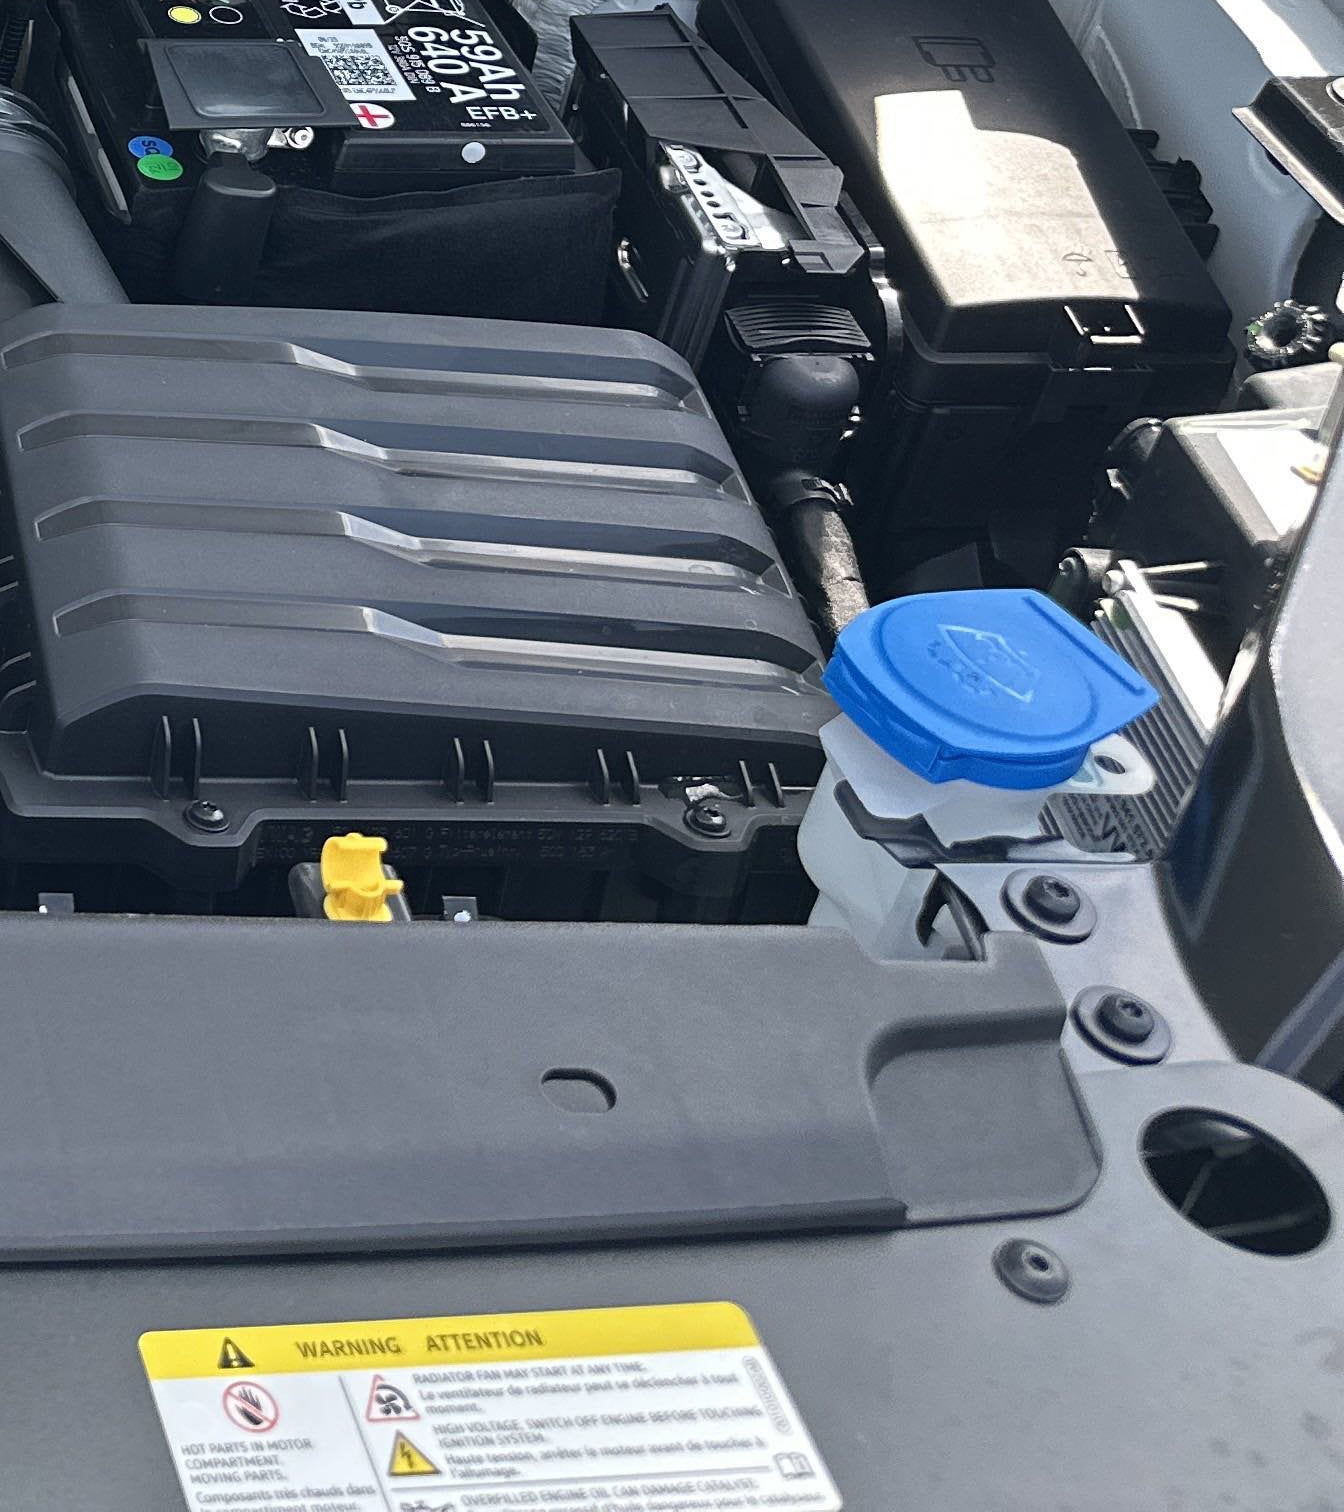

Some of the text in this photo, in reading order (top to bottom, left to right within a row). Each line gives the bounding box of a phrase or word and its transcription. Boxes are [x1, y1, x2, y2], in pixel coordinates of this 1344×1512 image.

[407, 26, 471, 76] 640
[439, 81, 488, 104] A
[449, 27, 526, 101] 59Ah
[465, 105, 537, 121] EFB+
[294, 1327, 544, 1359] WARNING ATTENTION
[412, 1371, 476, 1386] RADIATOR
[476, 1368, 502, 1383] FAN
[503, 1367, 530, 1381] MAY
[530, 1364, 568, 1379] START
[571, 1363, 586, 1376] AT
[586, 1362, 612, 1375] ANY
[419, 1388, 437, 1402] Le
[437, 1386, 505, 1401] ventilateur
[506, 1384, 523, 1398] de
[525, 1383, 583, 1396] radiateur
[584, 1379, 613, 1395] peut
[614, 1379, 630, 1390] se
[631, 1373, 700, 1389] déclencher
[711, 1372, 740, 1385] tout
[431, 1422, 465, 1436] HIGH
[525, 1416, 574, 1432] SWITCH
[574, 1414, 599, 1428] OFF
[601, 1410, 648, 1426] ENGINE
[648, 1407, 698, 1423] BEFORE
[700, 1404, 763, 1421] TOUCHING
[180, 1442, 207, 1457] HOT
[208, 1440, 250, 1455] PARTS
[250, 1439, 264, 1452] IN
[438, 1435, 496, 1450] IGNITION
[444, 1452, 485, 1466] Haute
[540, 1447, 583, 1461] arrêter
[584, 1444, 598, 1458] le
[600, 1444, 647, 1458] moteur
[648, 1441, 685, 1455] avant
[685, 1439, 703, 1453] de
[703, 1437, 754, 1452] toucher
[189, 1468, 289, 1486] MOVING PARTS.
[194, 1483, 376, 1506] Composants très chauds dans
[460, 1491, 539, 1507] OVERFILLED
[539, 1488, 588, 1505] ENGINE
[590, 1486, 611, 1500] OIL
[612, 1484, 641, 1498] CAN
[641, 1480, 697, 1496] DAMAGE
